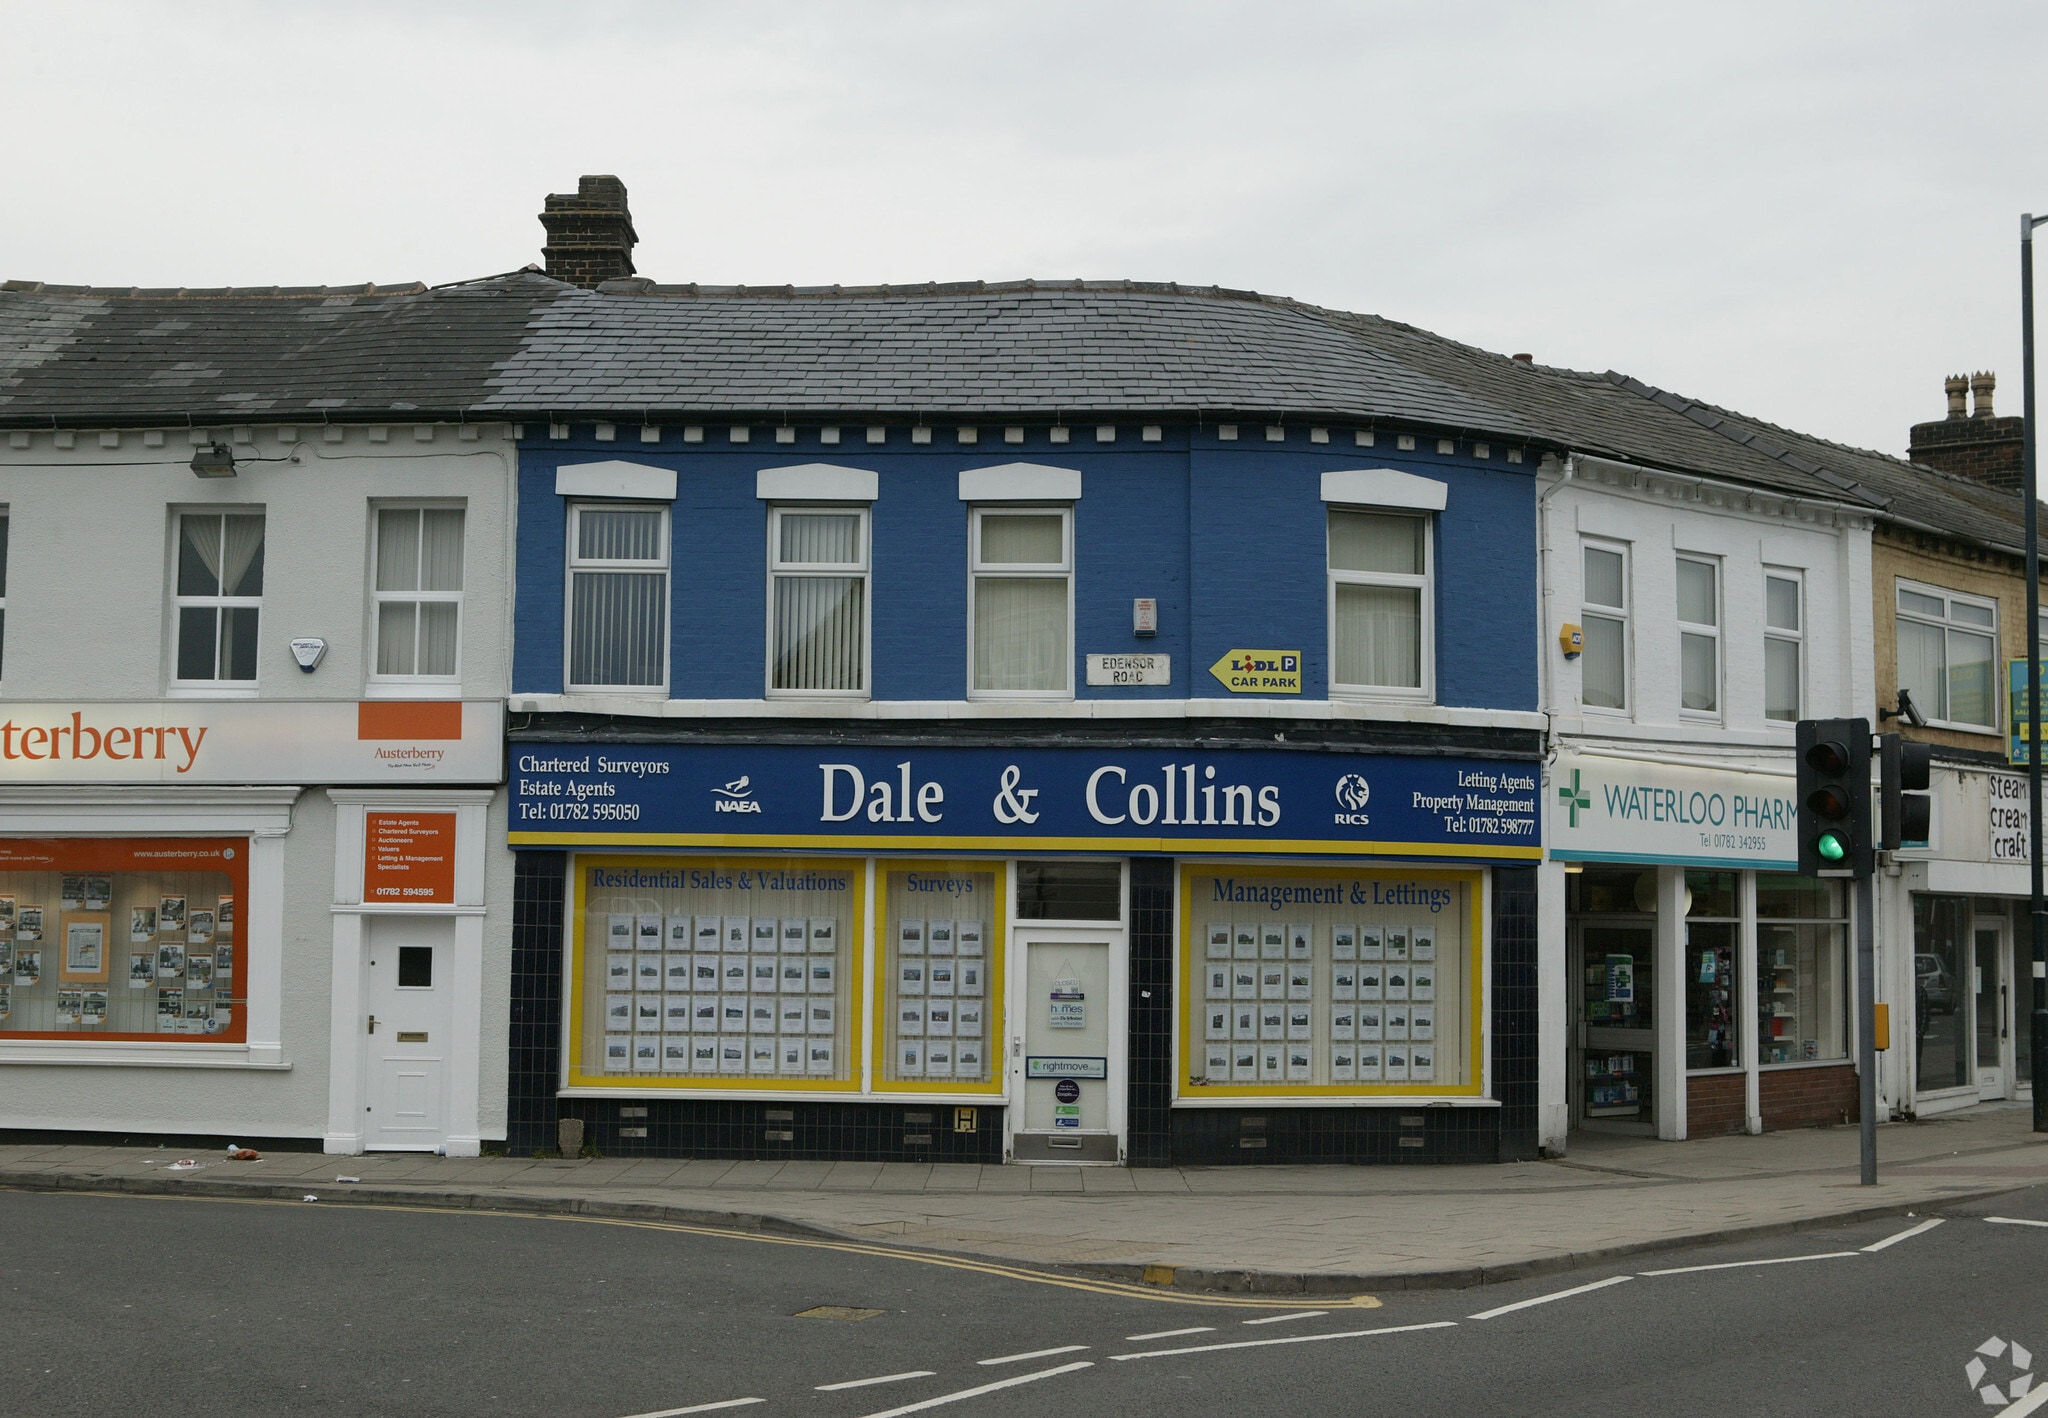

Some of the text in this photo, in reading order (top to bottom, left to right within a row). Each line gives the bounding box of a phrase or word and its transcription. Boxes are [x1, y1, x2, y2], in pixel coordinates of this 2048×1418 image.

[1102, 658, 1154, 669] EDENSOR
[1231, 677, 1296, 687] CAR PARK
[374, 747, 444, 761] Austerberry
[519, 756, 670, 778] Chartered Surveyors
[519, 779, 615, 801] Estate Agents
[1458, 770, 1534, 794] Letting Agents
[818, 761, 1281, 827] Dale & Collins
[1412, 792, 1534, 816] Property Management
[519, 804, 640, 821] Tel: 01782 595050
[715, 800, 762, 813] NAEA
[1603, 784, 1726, 826] WATERLOO
[1334, 814, 1369, 825] RICS
[1444, 816, 1534, 835] Tel: 01782 598777
[1700, 832, 1766, 850] Tel 01782 342955
[1994, 832, 2027, 859] craft
[134, 850, 220, 858] www.austerberry.co.uk
[593, 869, 846, 890] Residential Sales & Valuations
[907, 874, 972, 898] Surveys
[403, 888, 434, 896] 594595
[1213, 878, 1451, 913] Management & Lettings
